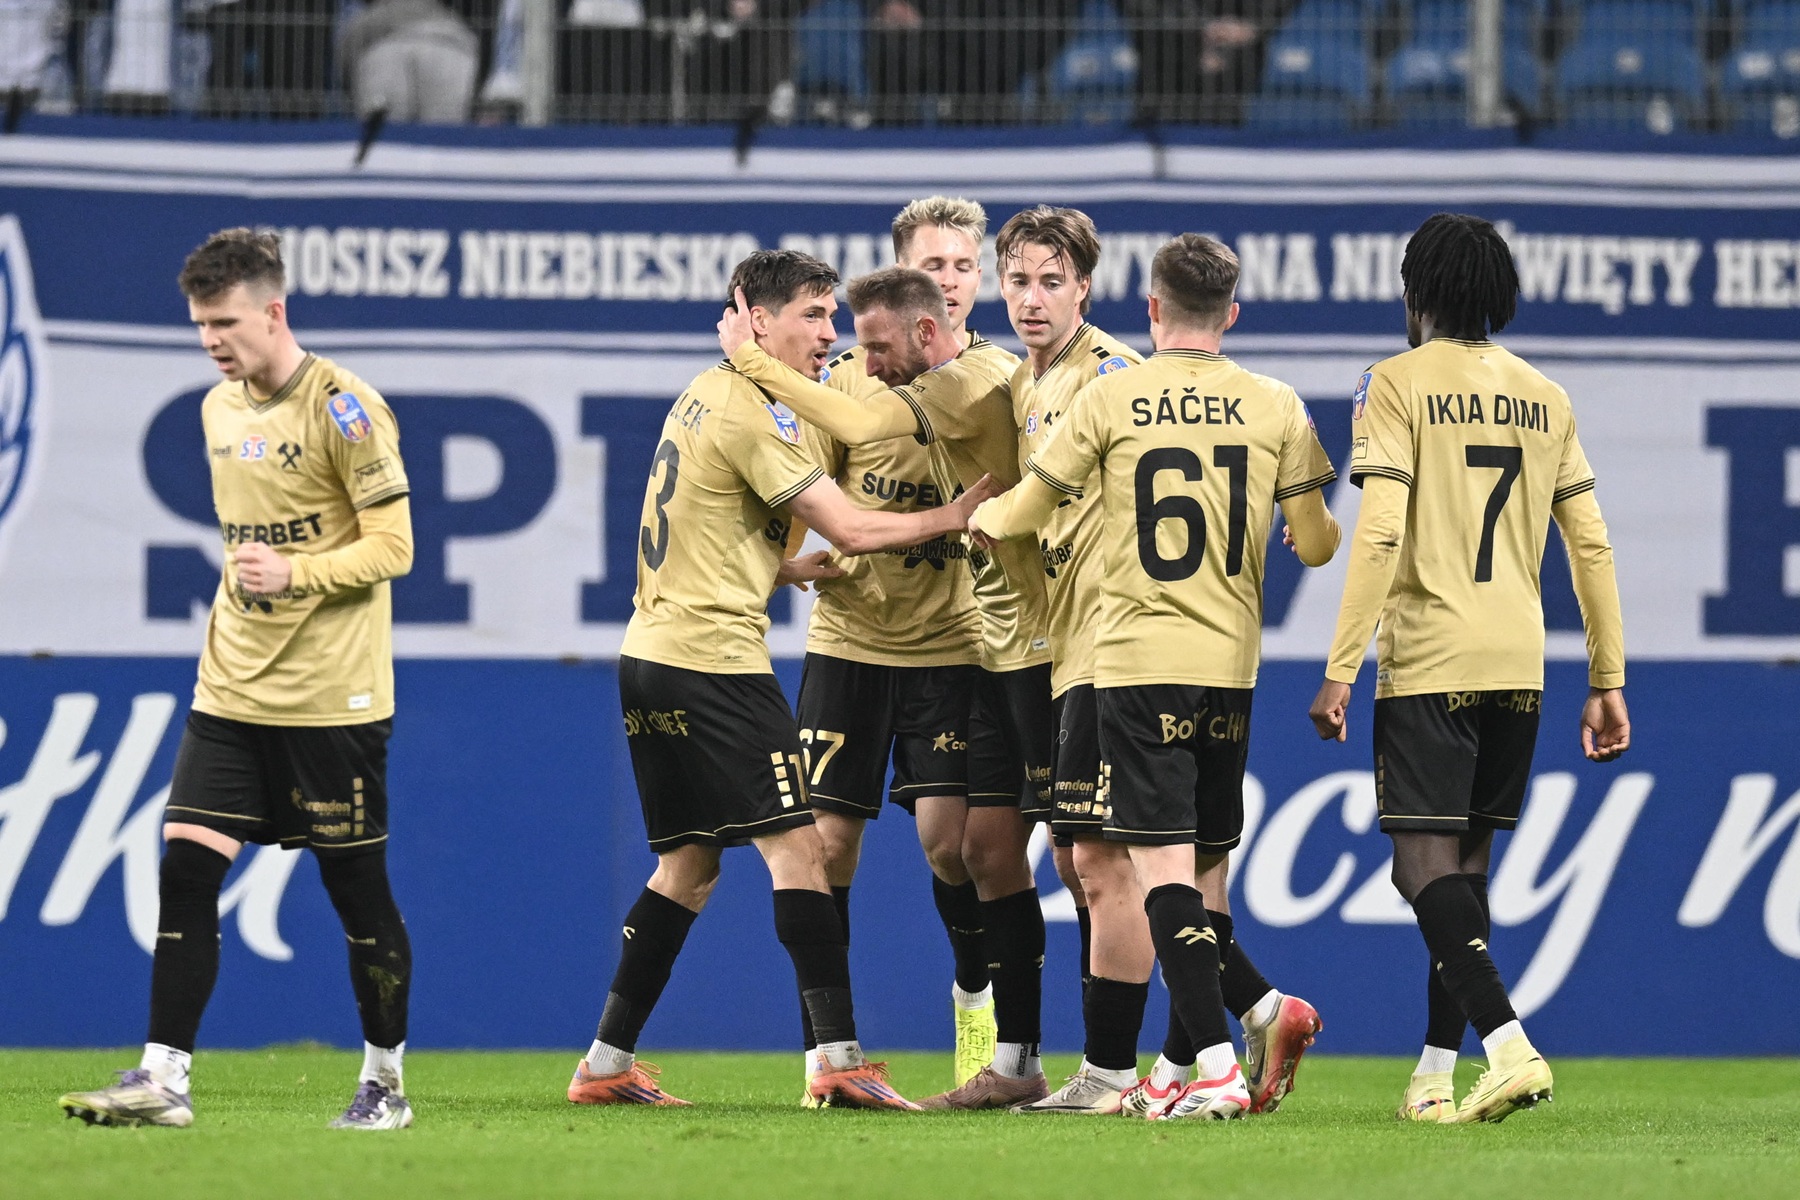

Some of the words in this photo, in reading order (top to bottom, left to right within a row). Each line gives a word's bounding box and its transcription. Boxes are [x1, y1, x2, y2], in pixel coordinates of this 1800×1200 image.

[1237, 234, 1322, 300] NA
[1713, 238, 1800, 312] HE
[1131, 387, 1245, 427] SÁČEK
[1427, 393, 1485, 425] IKIA
[1494, 394, 1549, 433] DIMI
[240, 436, 267, 460] STS
[1134, 444, 1249, 582] 61
[1465, 445, 1523, 583] 7
[1056, 801, 1092, 813] capelli
